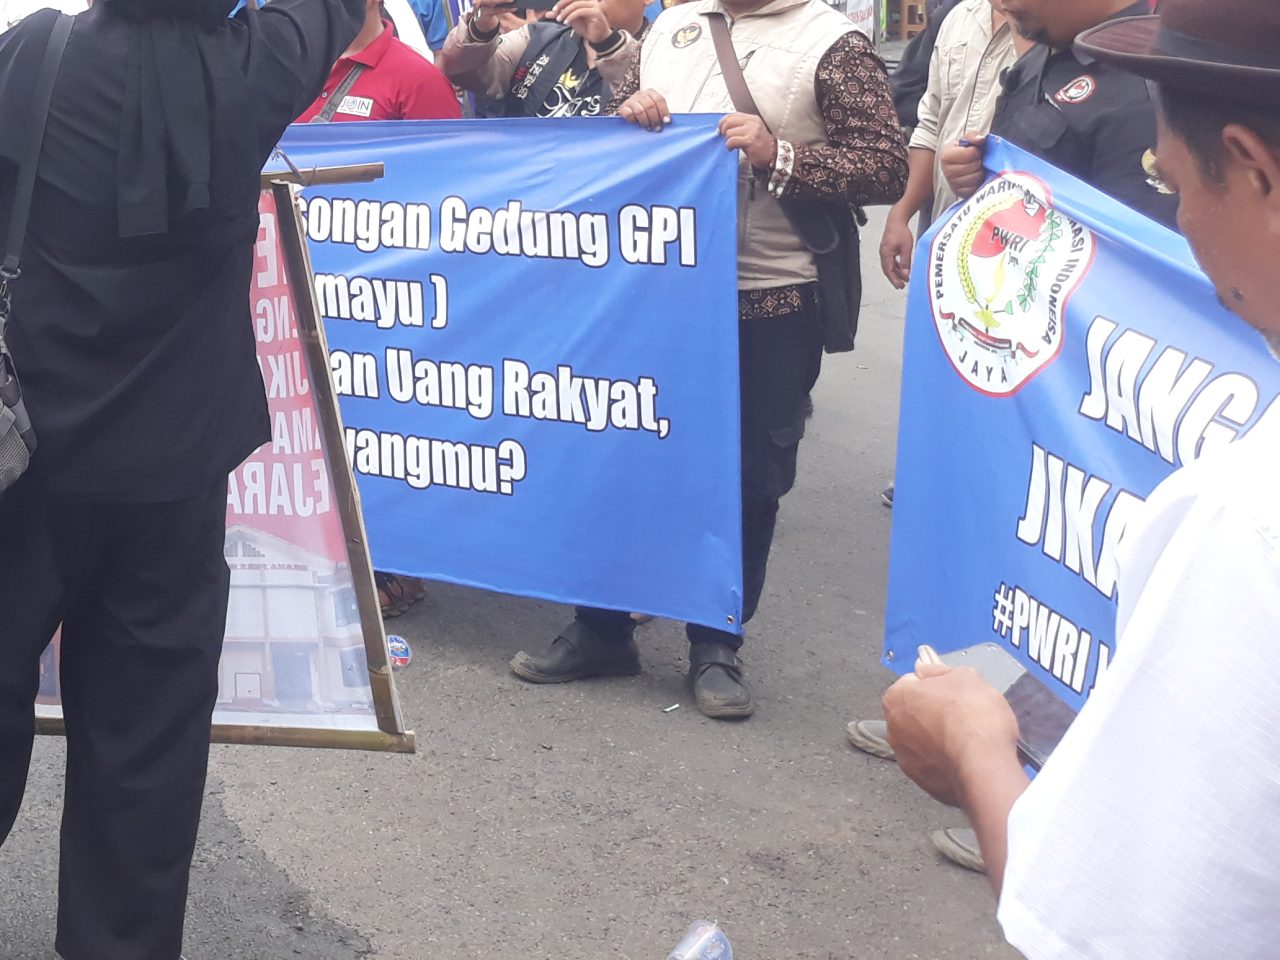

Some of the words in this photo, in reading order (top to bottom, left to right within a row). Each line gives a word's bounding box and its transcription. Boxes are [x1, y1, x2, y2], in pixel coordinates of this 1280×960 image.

[440, 195, 609, 267] Gedung
[619, 204, 697, 268] GPI
[935, 205, 971, 300] PEMERSATU
[314, 272, 424, 329] mayu
[385, 346, 494, 420] Uang
[502, 357, 670, 440] Rakyat,
[959, 350, 1008, 383] JAYA
[992, 581, 1093, 695] #PWRI
